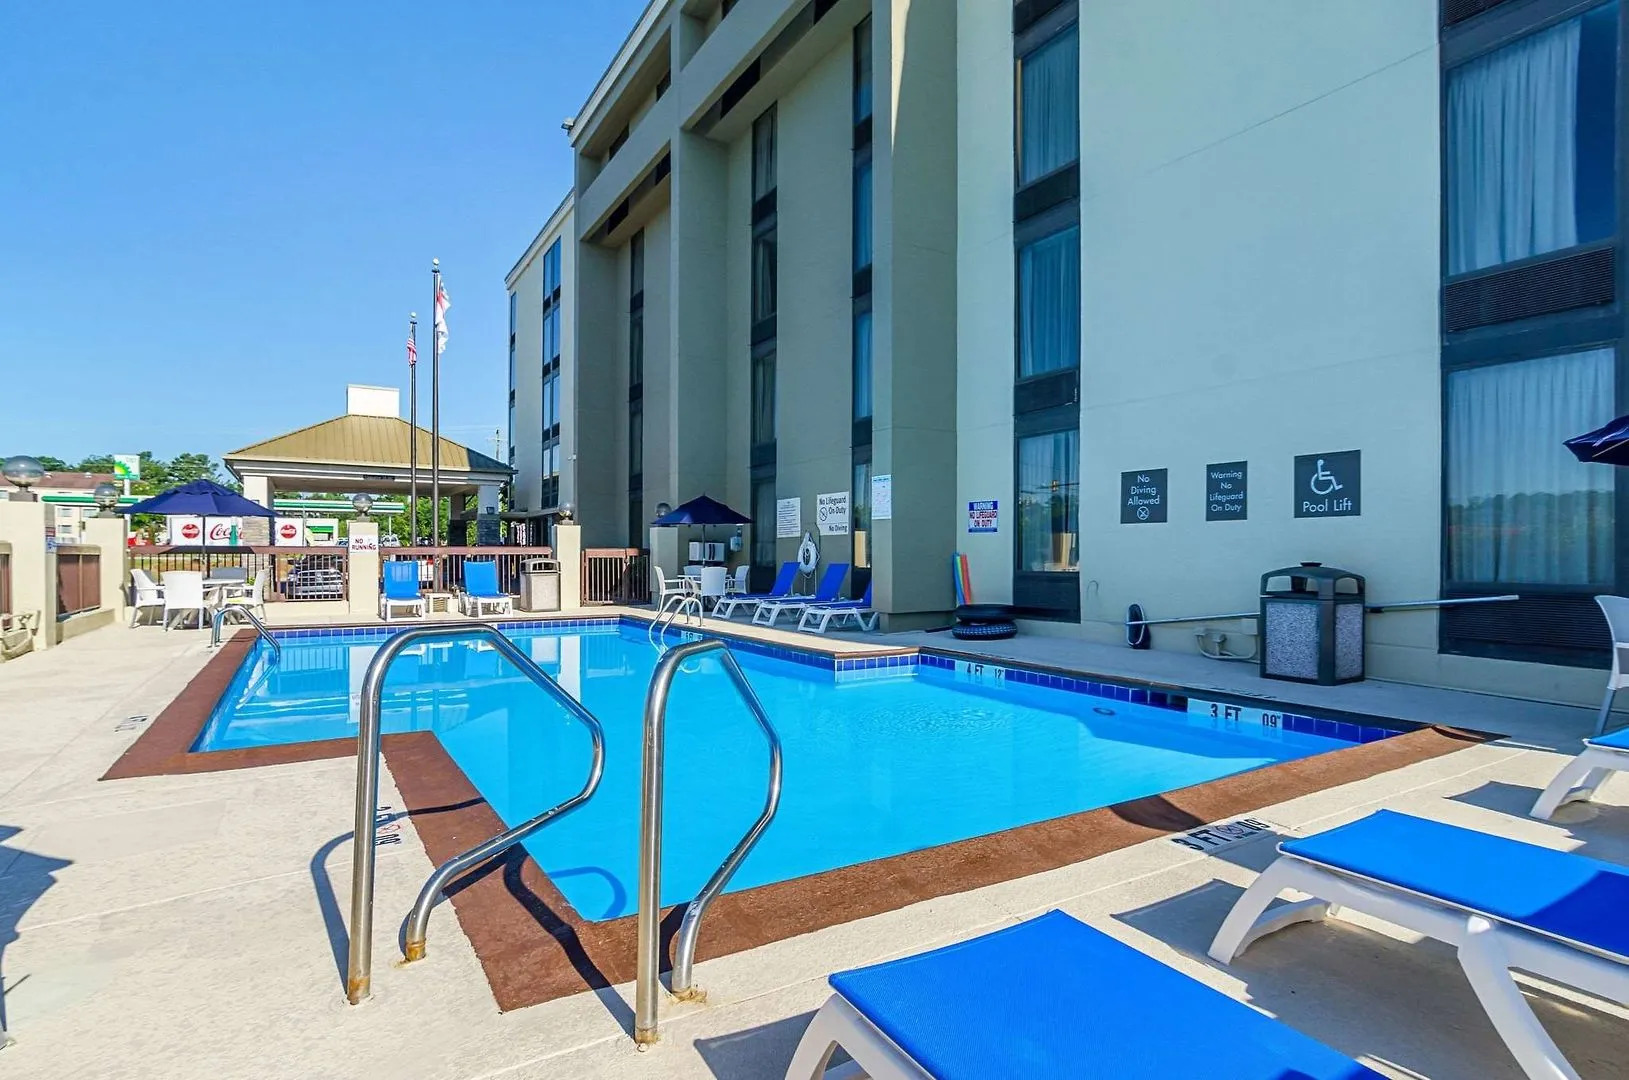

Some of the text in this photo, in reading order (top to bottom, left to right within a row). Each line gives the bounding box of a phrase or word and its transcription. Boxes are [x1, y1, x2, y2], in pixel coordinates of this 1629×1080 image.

[1137, 474, 1150, 483] No
[1210, 471, 1243, 480] Warning
[1130, 485, 1157, 496] Diving
[826, 496, 846, 506] Lifeguard
[1127, 494, 1160, 506] Allowed
[1209, 490, 1244, 503] Lifeguard
[1210, 503, 1242, 513] On Duty
[1302, 497, 1352, 513] Pool Lift
[969, 511, 997, 519] NO LIFEGUARD
[981, 519, 992, 527] DUTY
[835, 525, 847, 533] Diving
[351, 543, 377, 551] RUNNING
[975, 664, 984, 676] FT
[1210, 704, 1218, 718] 3
[1225, 706, 1242, 721] FT
[1187, 828, 1233, 846] FT
[1171, 838, 1205, 851] 3
